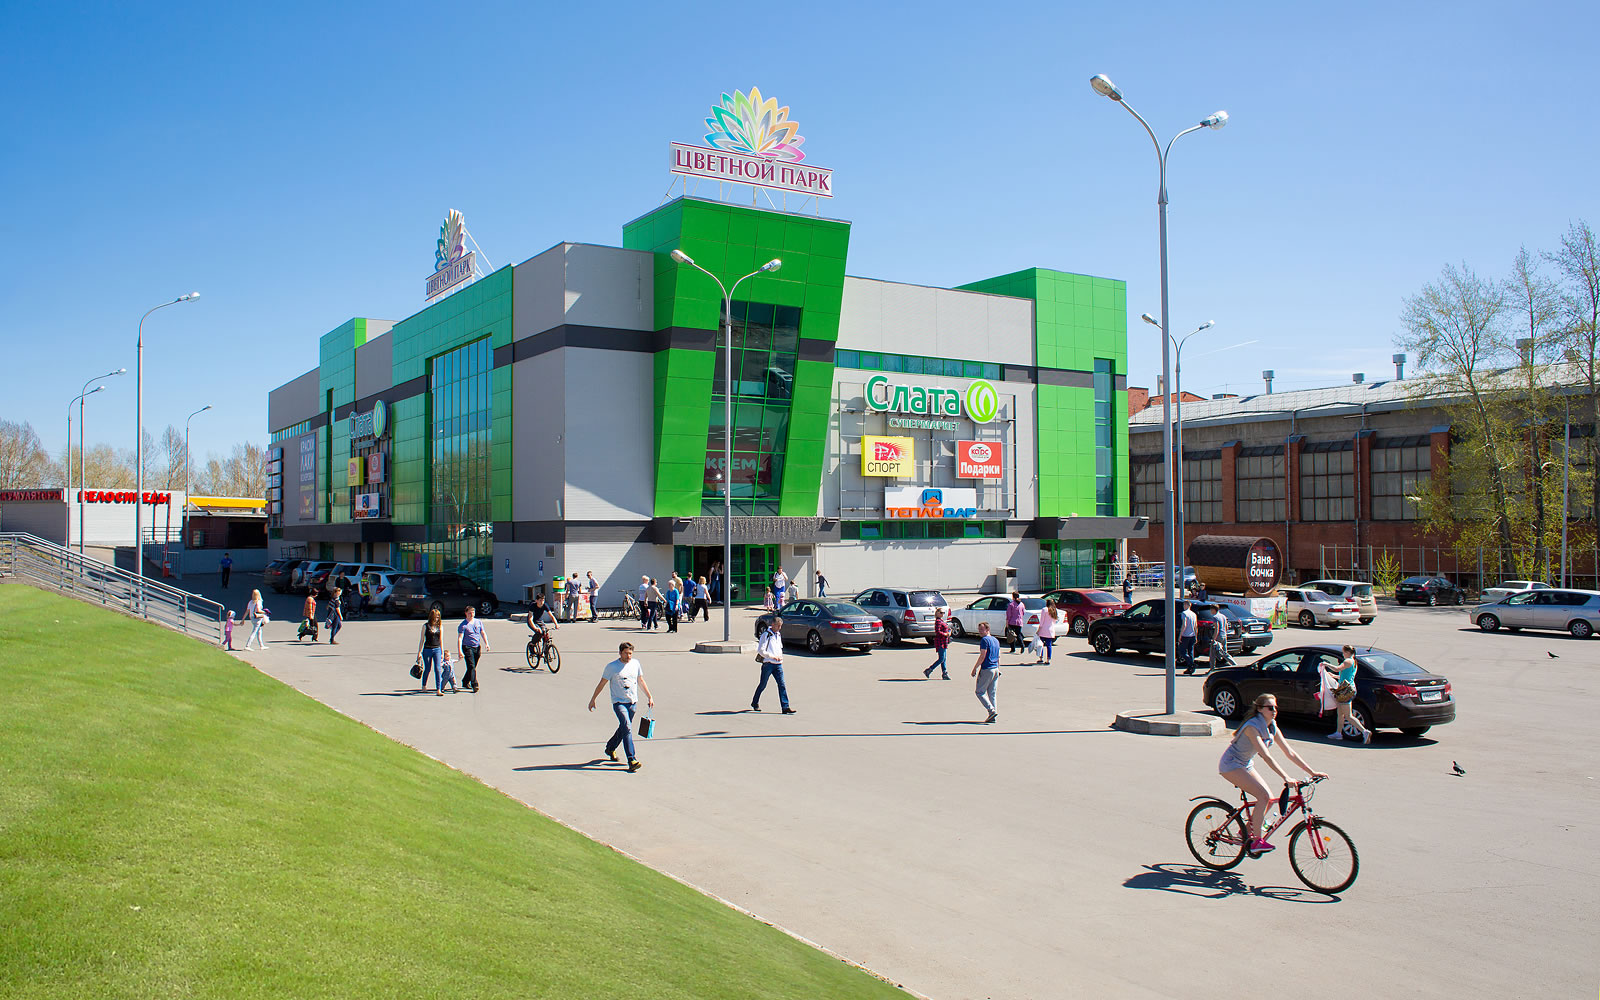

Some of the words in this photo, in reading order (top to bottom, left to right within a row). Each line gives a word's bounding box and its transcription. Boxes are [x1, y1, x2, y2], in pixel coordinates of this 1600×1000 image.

[676, 149, 774, 181] ЦВЕТНОЙ
[781, 167, 830, 191] ПАРК
[454, 257, 471, 279] ПАРК
[866, 375, 961, 417] Слата
[889, 418, 960, 431] СУПЕРМАРКЕТ
[867, 462, 901, 473] СПОРТ
[960, 462, 1000, 476] Подарки
[886, 507, 977, 518] ТЕПЛОДАР
[1251, 552, 1274, 565] Баня-
[1250, 565, 1274, 577] бочка
